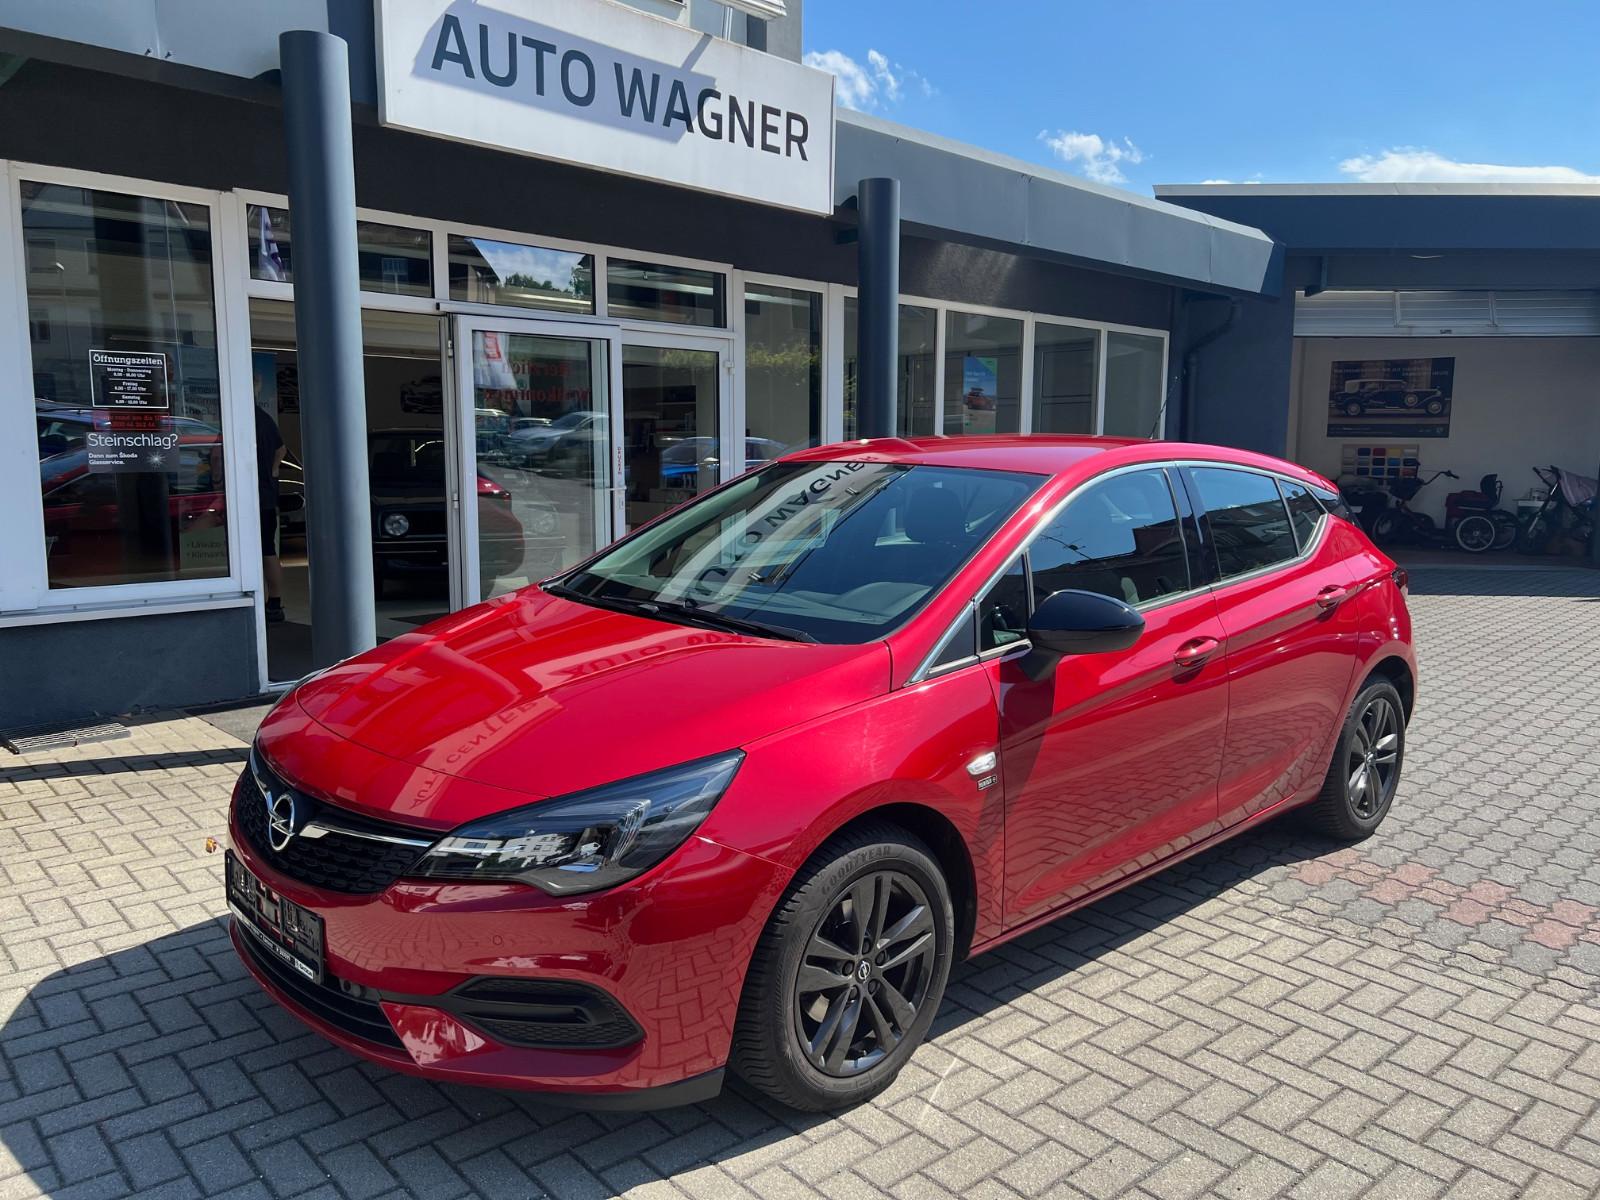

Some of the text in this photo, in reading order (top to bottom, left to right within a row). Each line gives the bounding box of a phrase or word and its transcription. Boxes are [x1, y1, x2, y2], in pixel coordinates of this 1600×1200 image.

[431, 13, 809, 162] AUTO WAGNER
[93, 353, 163, 365] Öffnungszeiten
[87, 433, 178, 450] Steinschlag?
